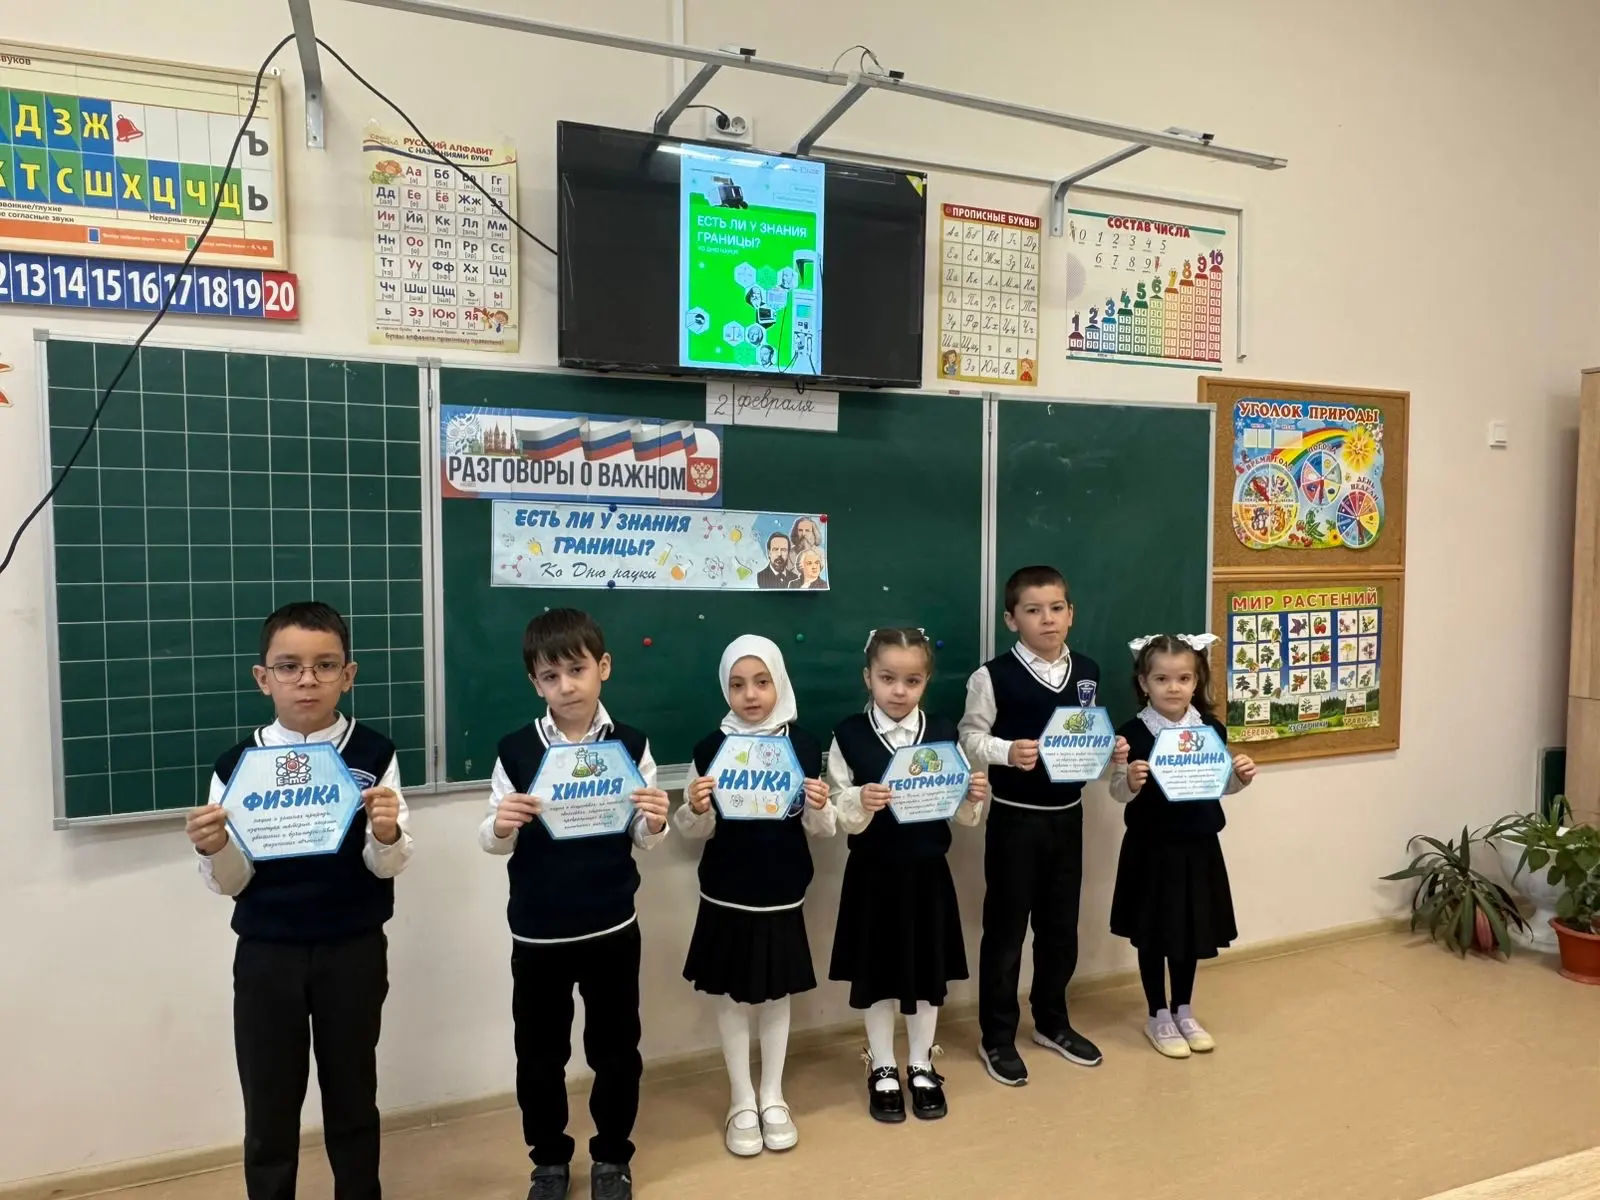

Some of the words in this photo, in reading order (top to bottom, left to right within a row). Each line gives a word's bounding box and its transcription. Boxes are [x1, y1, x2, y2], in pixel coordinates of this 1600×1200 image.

[0, 56, 31, 65] вуков
[15, 104, 41, 139] Д
[53, 109, 72, 135] З
[82, 112, 110, 140] Ж
[242, 130, 268, 156] Ъ
[404, 138, 446, 149] РУССИЙ
[449, 144, 493, 155] АЛФАВИТ
[406, 166, 422, 176] Аа
[435, 169, 449, 179] Бб
[491, 176, 502, 185] Гг
[20, 163, 40, 189] Т
[57, 167, 73, 193] С
[85, 170, 112, 196] Ш
[123, 174, 142, 200] Х
[153, 177, 175, 210] Ц
[186, 180, 206, 206] Ч
[214, 182, 240, 215] Щ
[248, 185, 268, 210] Ь
[376, 187, 395, 199] Дд
[407, 190, 421, 199] Ее
[436, 190, 449, 202] Ёё
[458, 195, 480, 205] Жж
[8, 212, 49, 220] согласные
[149, 214, 188, 223] Непарные
[377, 211, 394, 220] Ии
[406, 211, 423, 223] Йй
[435, 216, 450, 225] Кк
[462, 218, 478, 228] Лл
[487, 221, 507, 230] Мм
[953, 208, 1005, 223] ПРОПИСНЫЕ
[1008, 216, 1036, 228] БУКВЫ
[697, 216, 726, 228] ЕСТЬ
[729, 219, 746, 231] ЛИ
[750, 221, 757, 232] У
[760, 223, 807, 237] ЗНАНИЯ
[1107, 217, 1151, 232] СОСТАВ
[1155, 224, 1190, 238] ЧИСЛА
[378, 234, 395, 244] Нн
[406, 237, 423, 246] Оо
[435, 239, 451, 249] Пп
[463, 241, 477, 253] Рр
[491, 243, 504, 253] Сс
[697, 232, 760, 248] ГРАНИЦЫ?
[1079, 229, 1086, 240] 0
[1098, 232, 1103, 242] 1
[1113, 233, 1120, 244] 2
[1130, 235, 1136, 246] 3
[1146, 238, 1151, 249] 4
[1160, 240, 1166, 250] 5
[381, 258, 394, 267] Тт
[408, 259, 422, 272] Уу
[432, 262, 454, 274] Фф
[463, 264, 478, 273] Хх
[490, 265, 507, 277] Цц
[1096, 253, 1103, 263] 6
[1113, 255, 1118, 265] 7
[1129, 257, 1135, 267] 8
[1145, 258, 1151, 269] 9
[0, 261, 8, 294] 2
[15, 263, 46, 296] 13
[54, 266, 86, 299] 14
[92, 269, 121, 301] 15
[128, 271, 159, 309] 16
[164, 272, 193, 306] 17
[199, 275, 228, 307] 18
[233, 278, 261, 310] 19
[265, 280, 295, 312] 20
[380, 282, 395, 291] Чч
[405, 283, 426, 293] Шш
[433, 285, 455, 297] Щщ
[1072, 314, 1080, 331] 1
[1089, 307, 1098, 324] 2
[1105, 300, 1115, 316] 3
[1121, 294, 1130, 308] 4
[1137, 282, 1146, 299] 5
[1152, 279, 1161, 293] 6
[1168, 270, 1177, 288] 7
[1183, 263, 1191, 279] 8
[1197, 256, 1207, 272] 9
[1209, 250, 1223, 265] 10
[409, 307, 423, 316] Ээ
[433, 309, 455, 319] Юю
[465, 311, 478, 320] Яя
[714, 394, 728, 416] 2
[736, 386, 814, 416] февраля
[1238, 402, 1302, 418] УГОЛОК
[1309, 407, 1379, 422] ПРИРОДЫ
[448, 456, 574, 486] РАЗГОВОРЫ
[580, 462, 592, 485] О
[598, 463, 686, 491] ВАЖНОМ
[515, 510, 561, 528] ЕСТЬ
[565, 511, 592, 528] ЛИ
[600, 512, 612, 530] У
[616, 513, 691, 533] ЗНАНИЯ
[553, 537, 655, 557] ГРАНИЦЫ?
[541, 563, 562, 579] Ко
[573, 564, 607, 579] Дню
[612, 569, 657, 584] науки
[1233, 597, 1274, 610] МИР
[1283, 587, 1377, 608] РАСТЕНИЙ
[1044, 735, 1111, 748] БИОЛОГИЯ
[1156, 753, 1225, 766] МЕДИЦИНА
[552, 778, 623, 800] ХИМИЯ
[718, 769, 790, 792] НАУКА
[888, 773, 964, 791] ГЕОГРАФИЯ
[243, 784, 339, 811] ФИЗИКА
